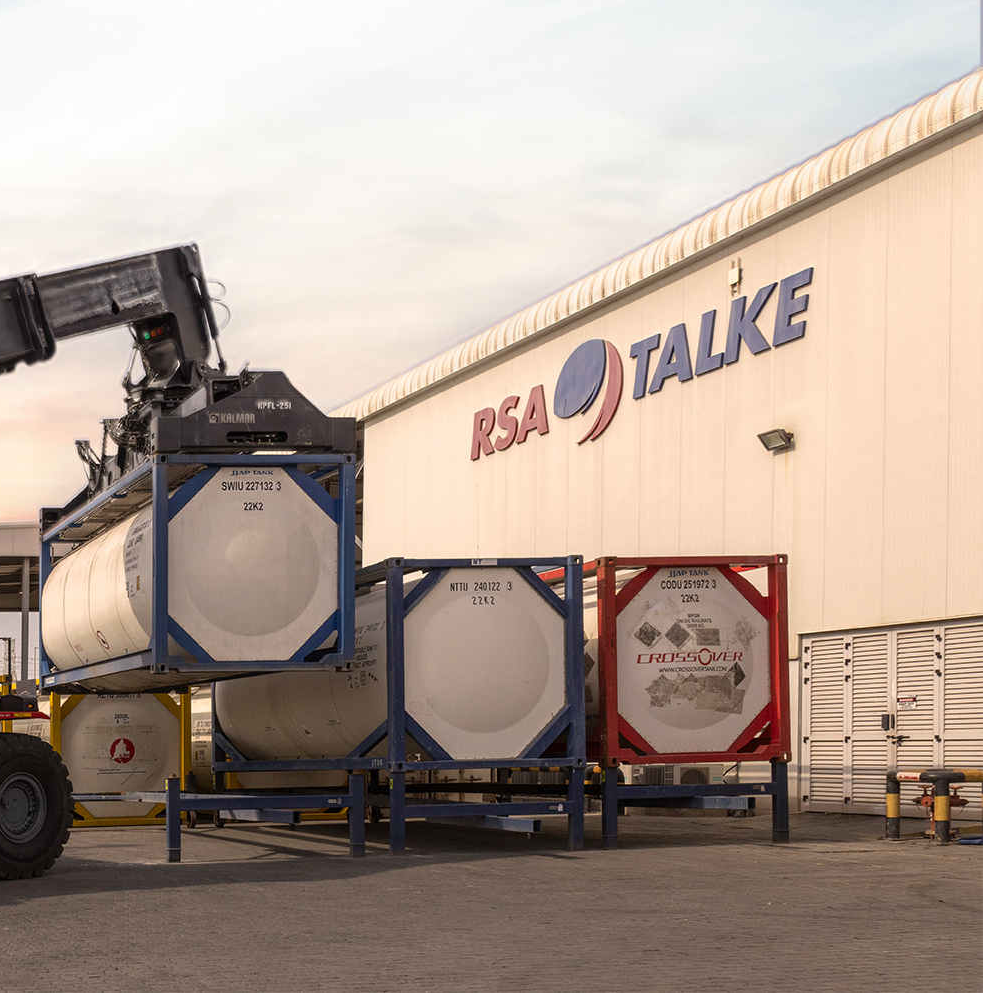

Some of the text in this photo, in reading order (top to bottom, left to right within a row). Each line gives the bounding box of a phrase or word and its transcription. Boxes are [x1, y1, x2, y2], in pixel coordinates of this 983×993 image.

[471, 267, 814, 461] RSA TALKE
[257, 402, 292, 410] HPFL-251
[220, 413, 256, 424] KALMAR
[221, 481, 282, 491] SWIU 227132 3
[243, 502, 264, 511] 22K2
[668, 570, 687, 578] JJAP
[450, 581, 513, 591] NTTU 240122 3
[660, 580, 717, 589] CODU 251972 3
[472, 596, 495, 605] 22K2
[680, 594, 700, 603] 22K2
[637, 648, 743, 665] CROSSOVER
